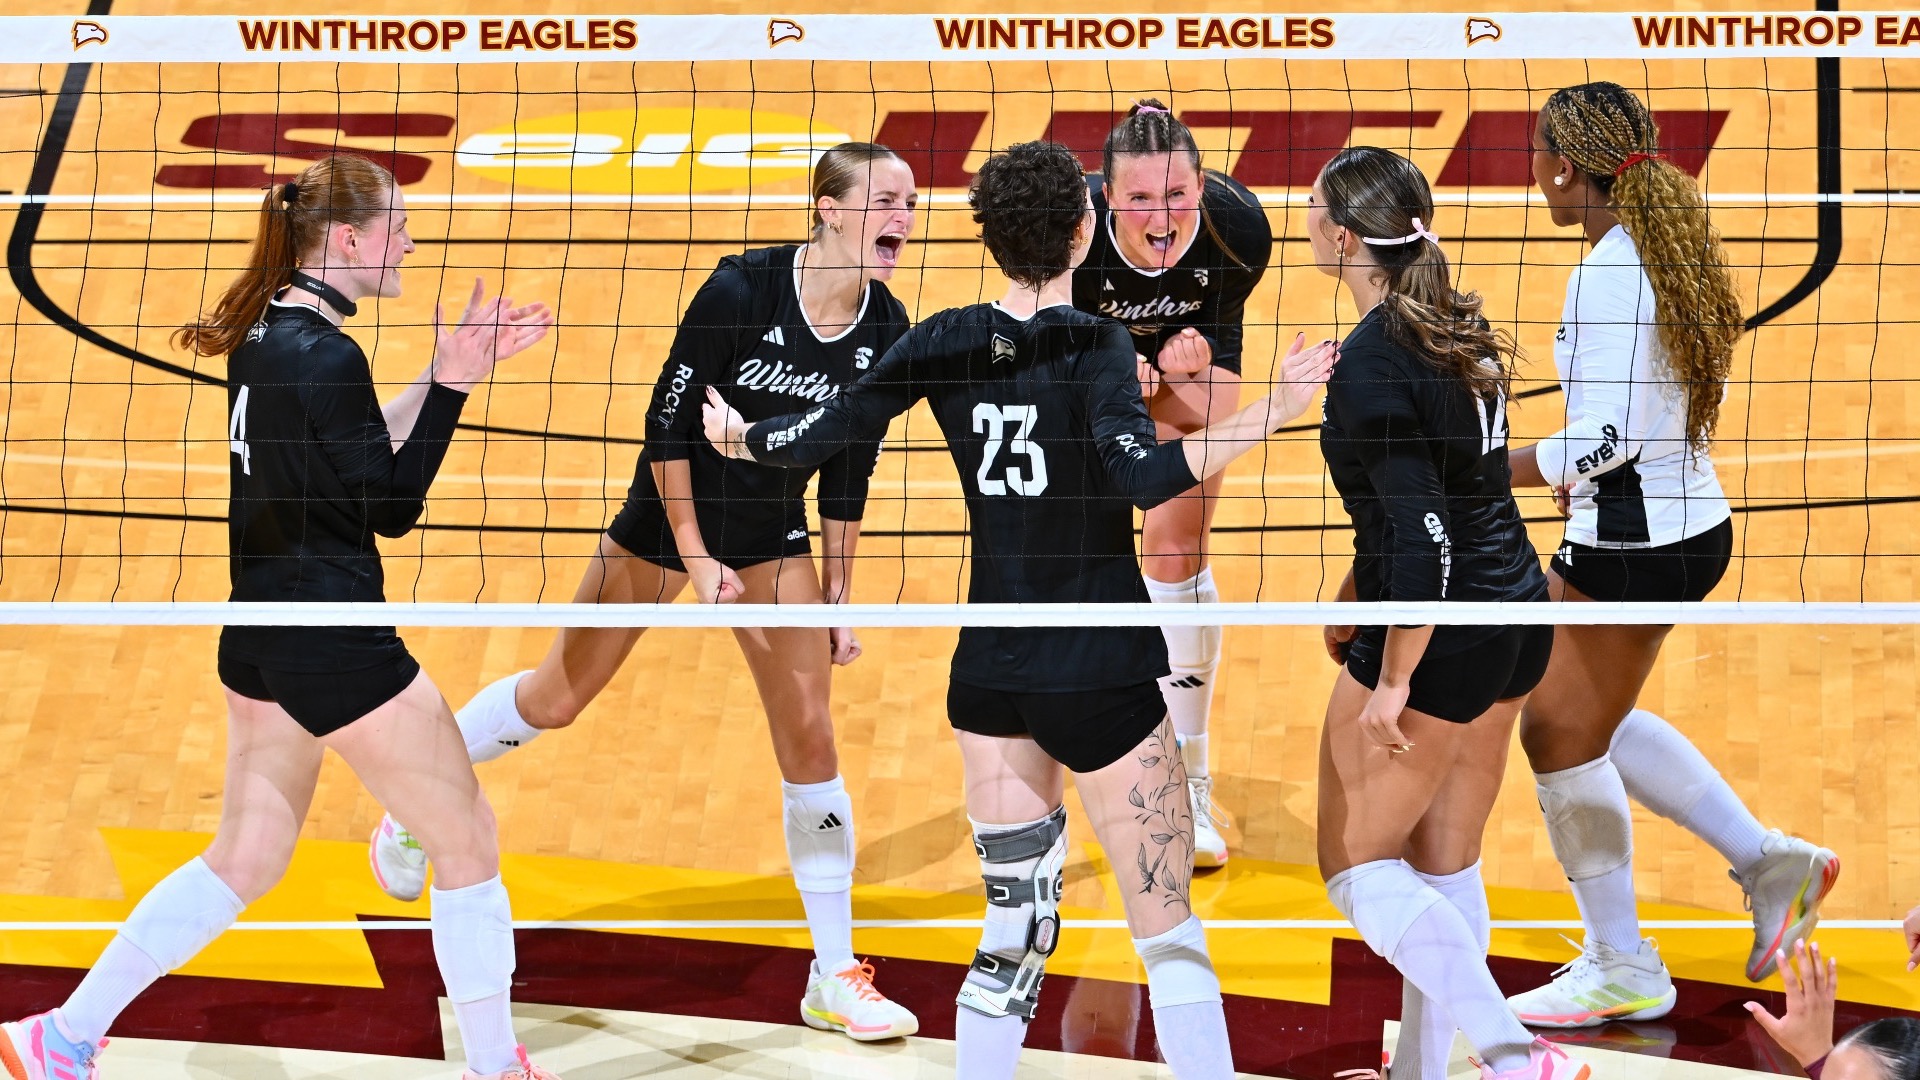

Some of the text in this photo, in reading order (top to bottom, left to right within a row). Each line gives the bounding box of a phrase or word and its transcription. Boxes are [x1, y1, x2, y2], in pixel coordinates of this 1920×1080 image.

[238, 18, 638, 52] WINTHROP EAGLES
[934, 16, 1336, 50] WINTHROP EAGLES
[1632, 16, 1864, 48] WINTHROP
[736, 358, 840, 403] Winthr
[229, 384, 251, 476] 4
[972, 402, 1048, 497] 23
